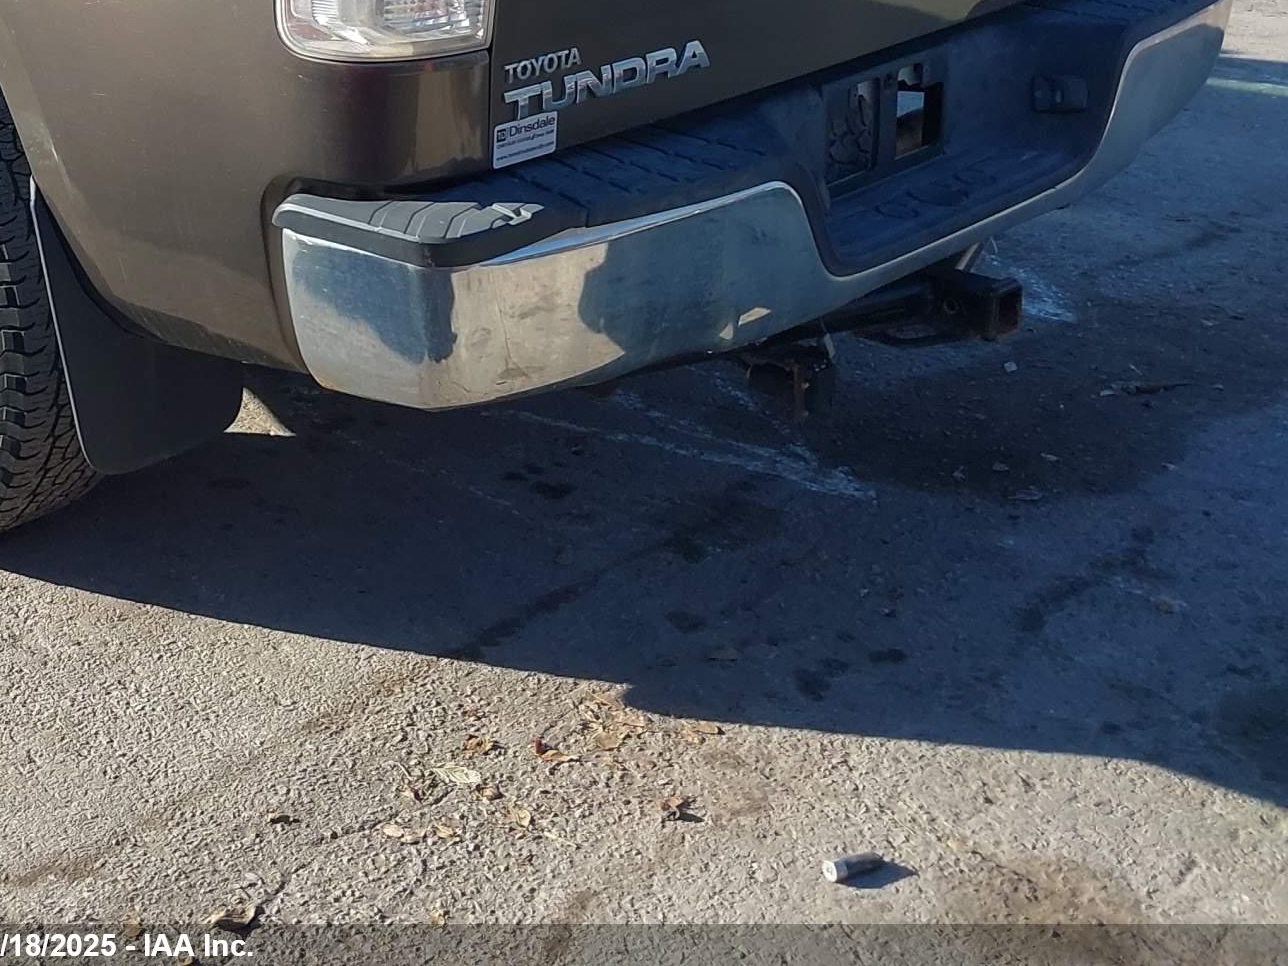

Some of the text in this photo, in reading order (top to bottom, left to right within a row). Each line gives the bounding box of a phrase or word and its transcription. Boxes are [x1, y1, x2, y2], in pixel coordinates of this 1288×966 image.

[503, 39, 711, 121] TUNDRA
[504, 47, 582, 83] TOYOTA
[509, 116, 556, 138] Dinsdale
